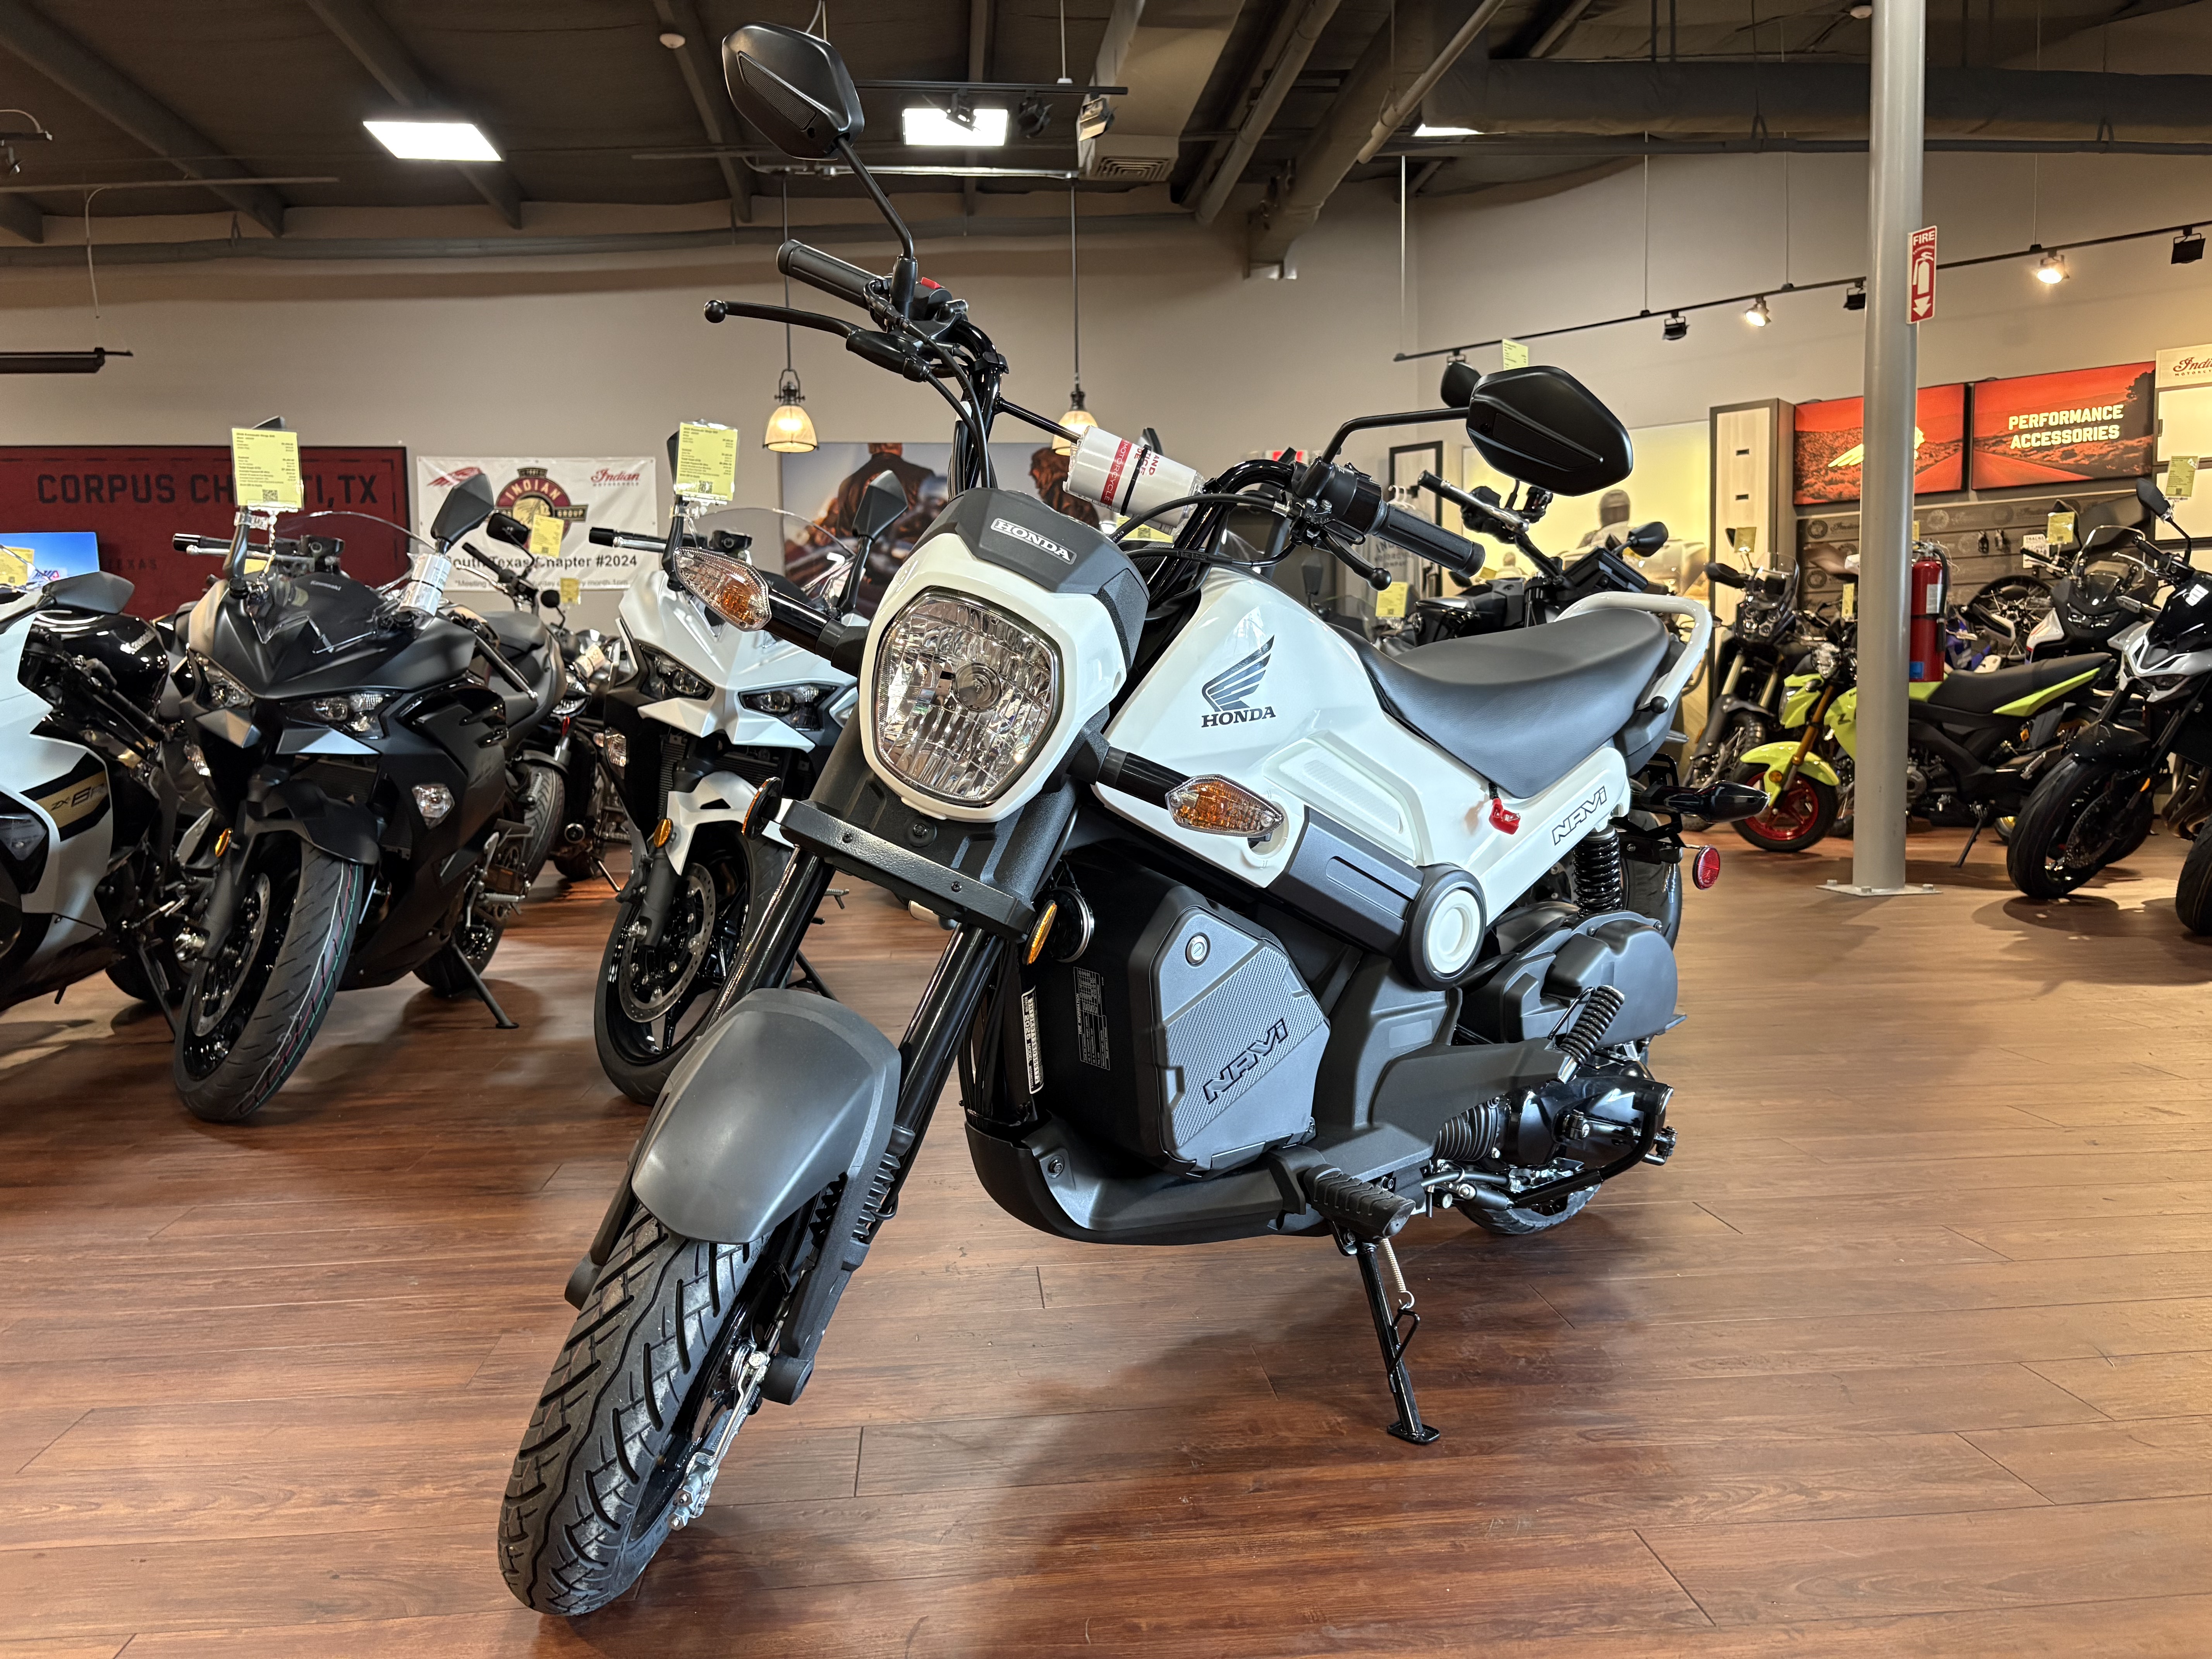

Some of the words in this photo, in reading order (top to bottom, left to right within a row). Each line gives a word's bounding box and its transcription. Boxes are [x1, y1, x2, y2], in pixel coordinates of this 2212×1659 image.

[1913, 230, 1935, 246] FIRE
[2008, 404, 2124, 431] PERFORMANCE
[2009, 425, 2120, 450] ACCESSORIES
[591, 468, 640, 483] Indian
[1104, 443, 1128, 500] MOTORCYCLE
[1149, 455, 1160, 476] AND
[37, 474, 175, 503] CORPUS
[505, 479, 561, 501] INDIAN
[557, 508, 584, 518] GROUP
[994, 520, 1071, 562] HONDA
[596, 555, 637, 567] #2024
[1202, 706, 1276, 727] HONDA
